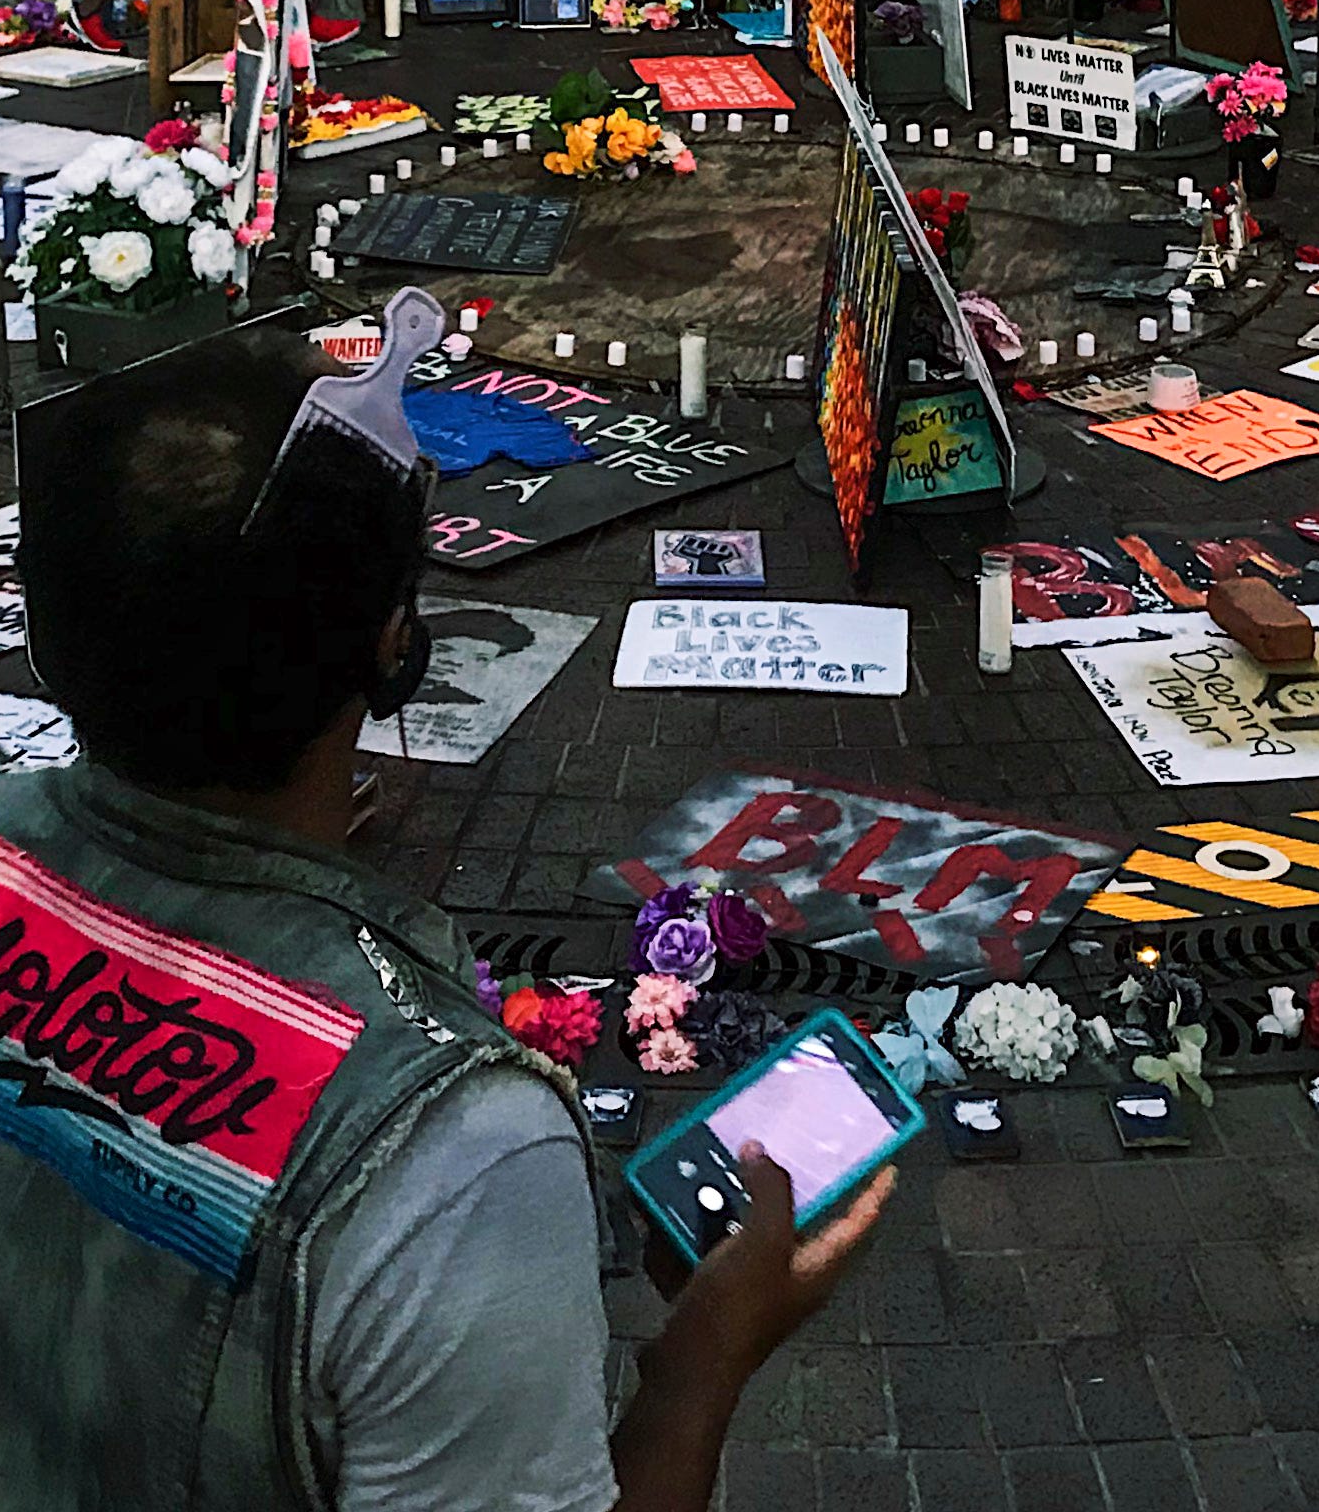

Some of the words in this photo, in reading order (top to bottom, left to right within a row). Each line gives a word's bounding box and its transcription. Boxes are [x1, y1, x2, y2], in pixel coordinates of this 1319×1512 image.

[1041, 48, 1070, 65] LIVES
[1075, 53, 1124, 73] MATTER
[1060, 70, 1085, 85] Until
[1014, 80, 1048, 98] BLACK
[1051, 86, 1079, 104] LIVES
[1082, 92, 1130, 113] MATTER
[452, 370, 611, 413] NOT
[596, 414, 749, 466] BLUE
[1105, 396, 1263, 441] WHEN
[889, 440, 982, 492] Taylor
[652, 604, 815, 631] Black
[674, 629, 821, 654] Lives
[643, 655, 888, 684] Matter
[1146, 669, 1232, 746] Taylor
[1170, 644, 1296, 756] Breonna
[684, 790, 1084, 943] BLM
